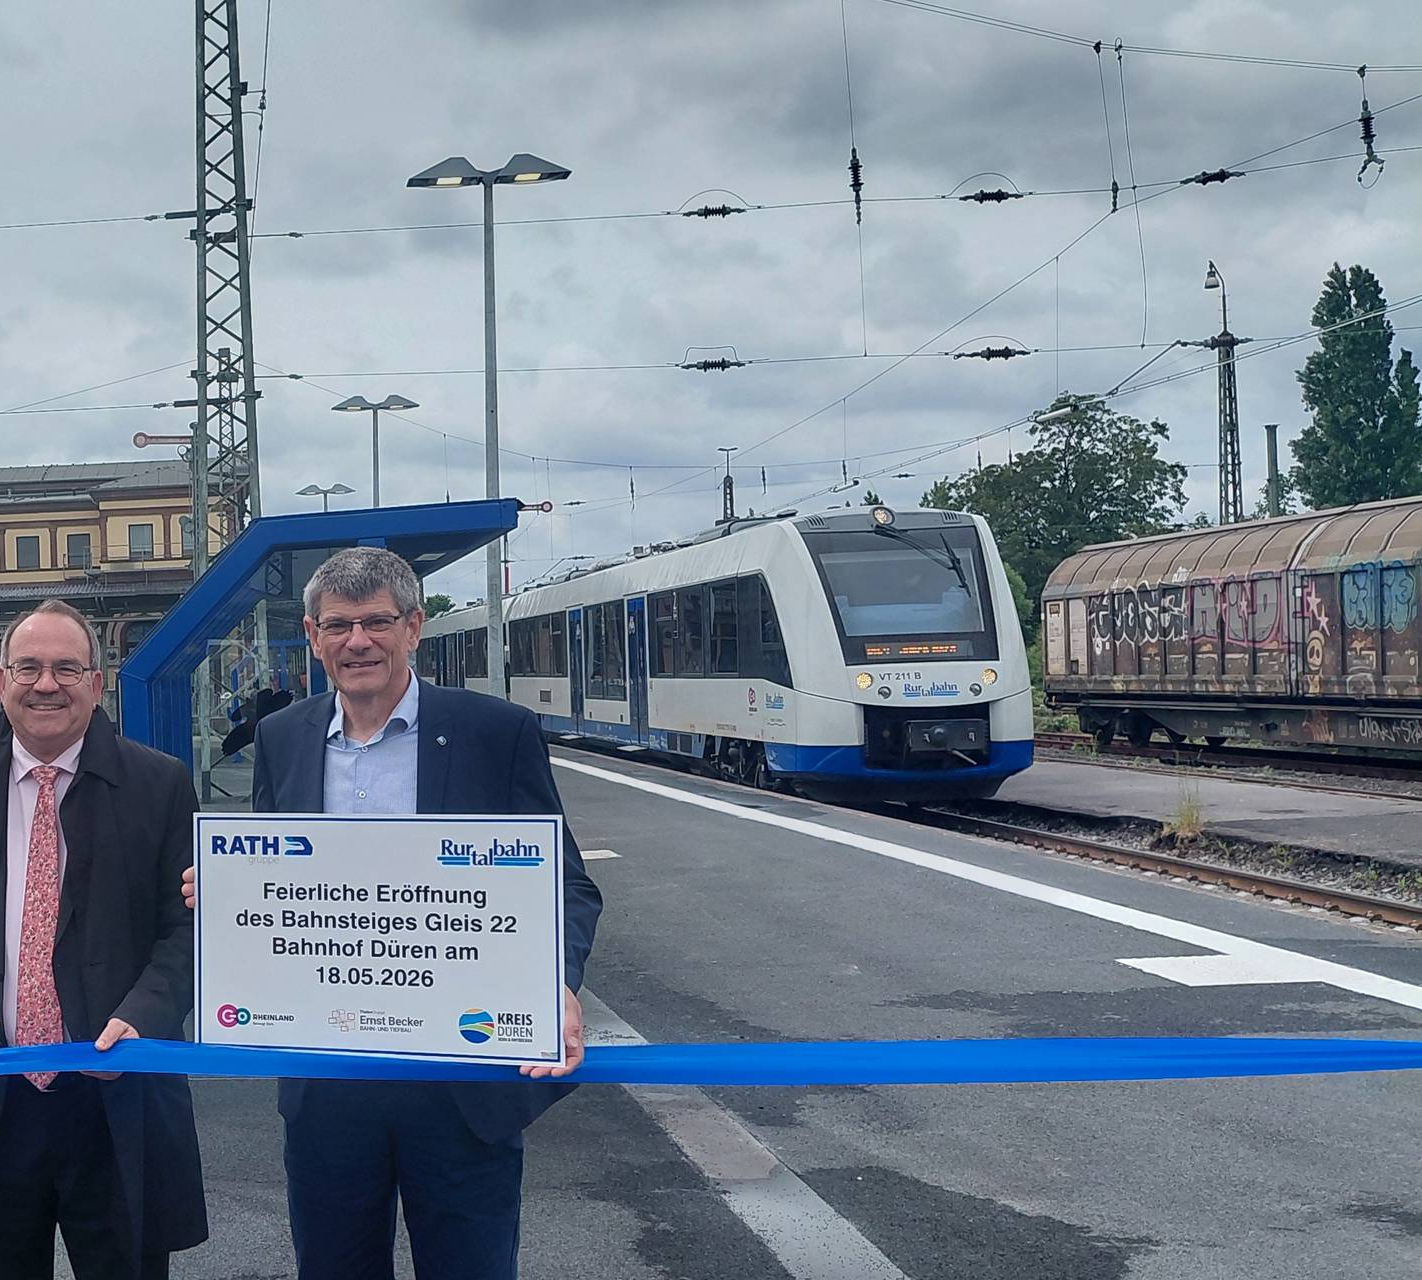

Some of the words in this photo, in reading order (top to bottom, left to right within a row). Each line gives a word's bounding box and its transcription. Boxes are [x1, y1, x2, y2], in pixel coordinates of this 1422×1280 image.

[903, 681, 960, 697] Rurtalbahn
[212, 836, 279, 855] RATH
[437, 838, 545, 867] Rurtalbahn
[264, 883, 368, 901] Feierliche
[377, 885, 486, 908] Eröffnung
[236, 910, 273, 927] des
[282, 910, 417, 934] Bahnsteiges
[426, 914, 482, 932] Gleis
[491, 916, 516, 932] 22
[273, 937, 363, 956] Bahnhof
[372, 940, 436, 959] Düren
[446, 946, 478, 960] am
[316, 967, 433, 987] 18.05.2026
[252, 1014, 295, 1022] RHEINLAND
[359, 1015, 388, 1026] Ernst
[390, 1016, 424, 1028] Becker
[497, 1012, 533, 1026] KREIS
[497, 1025, 533, 1038] DÜREN
